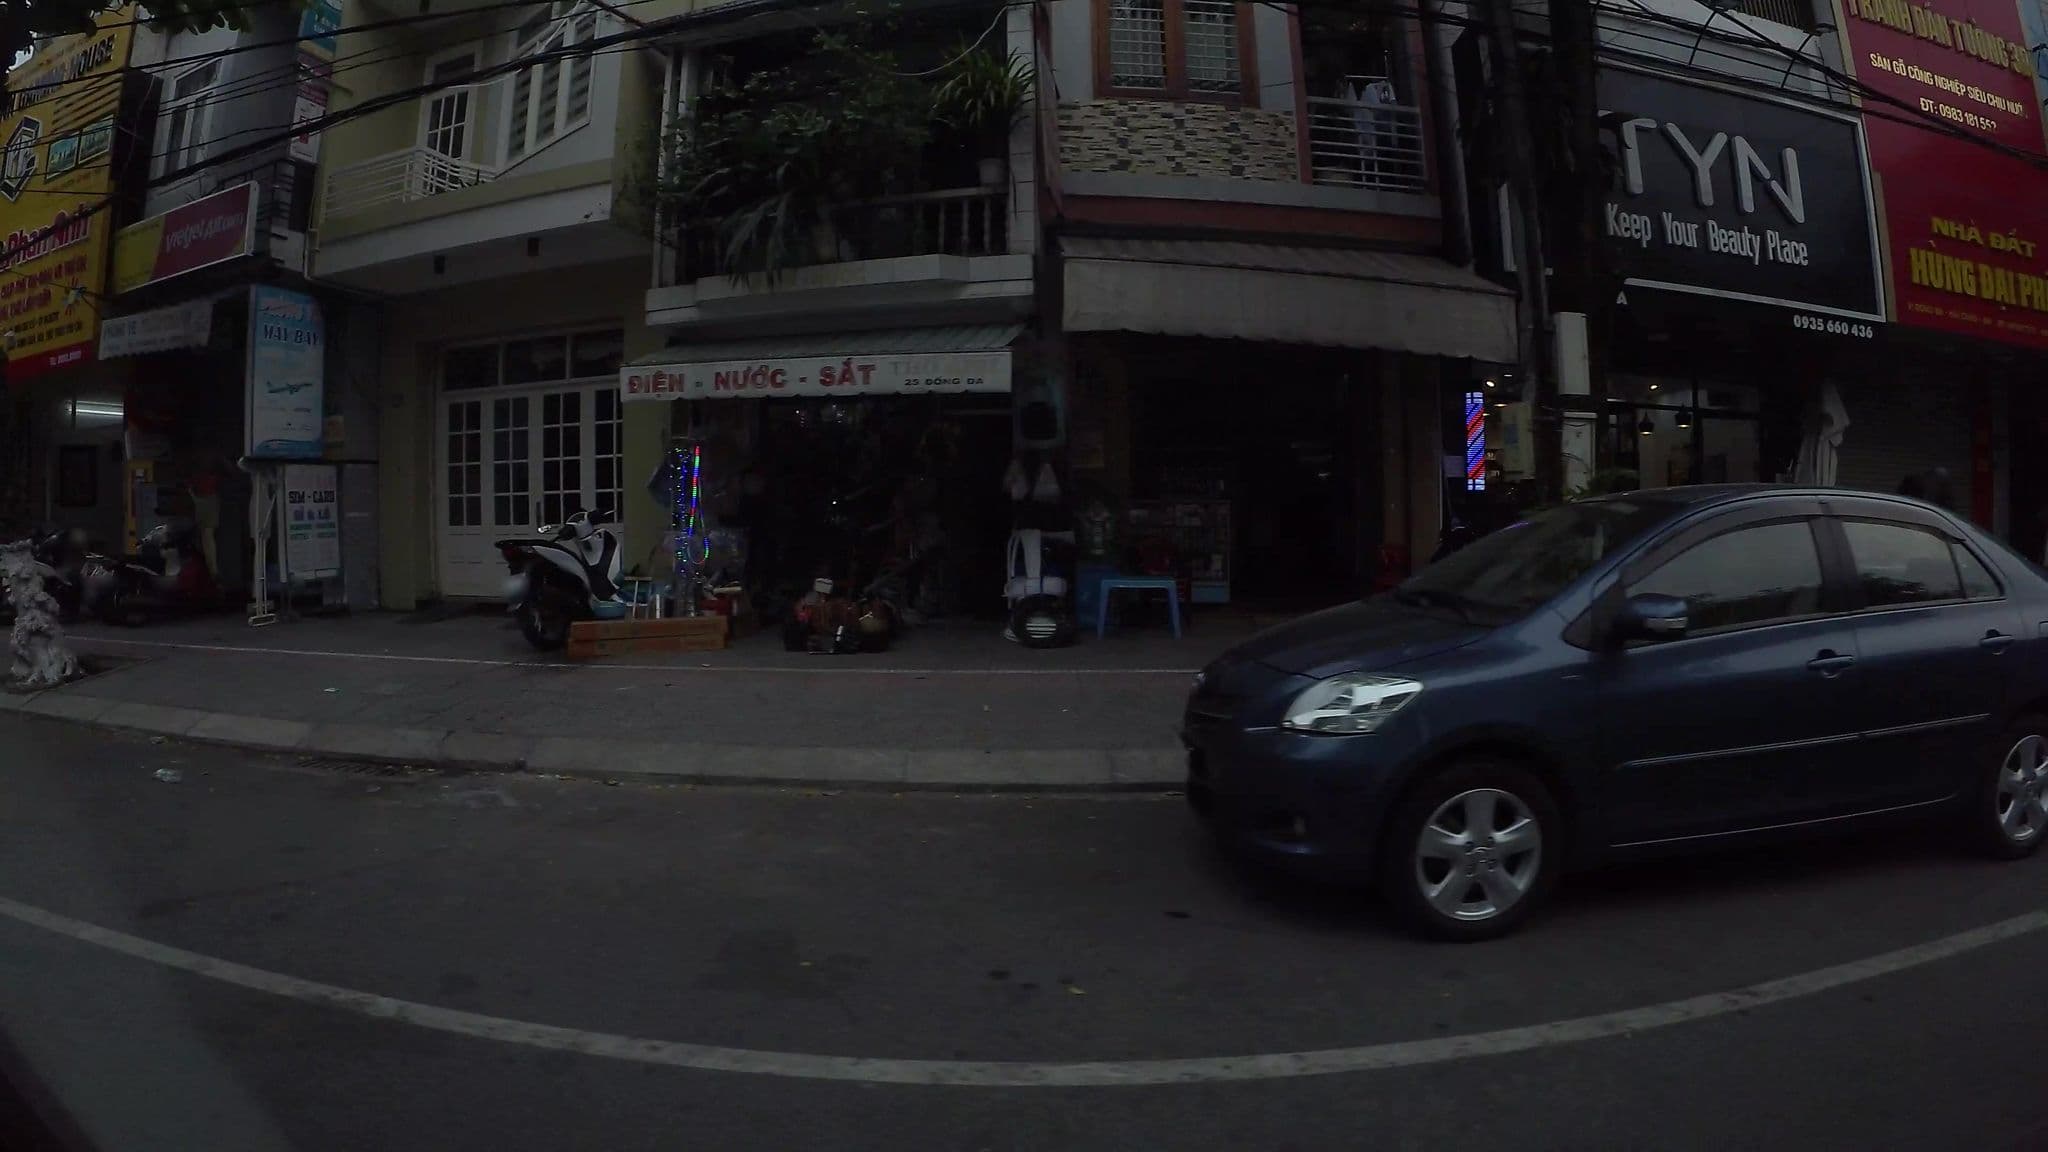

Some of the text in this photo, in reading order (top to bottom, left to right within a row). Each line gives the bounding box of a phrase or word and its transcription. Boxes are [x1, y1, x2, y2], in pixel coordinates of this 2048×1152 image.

[1869, 52, 1892, 72] SÀN
[1892, 57, 1907, 77] GỖ
[1907, 65, 1934, 86] CÔNG
[1933, 74, 1966, 97] NGHIỆP
[1939, 103, 1964, 123] 0983
[1964, 111, 1980, 129] 181
[1606, 202, 1809, 267] Keep Your Beauty Place
[1930, 215, 2037, 260] NHÀ ĐẤT
[1908, 239, 1977, 298] HÙNG
[1793, 314, 1873, 339] 0935 660 436
[628, 370, 686, 398] ĐIỆN
[714, 364, 788, 392] NƯỚC
[818, 356, 877, 388] SẮT
